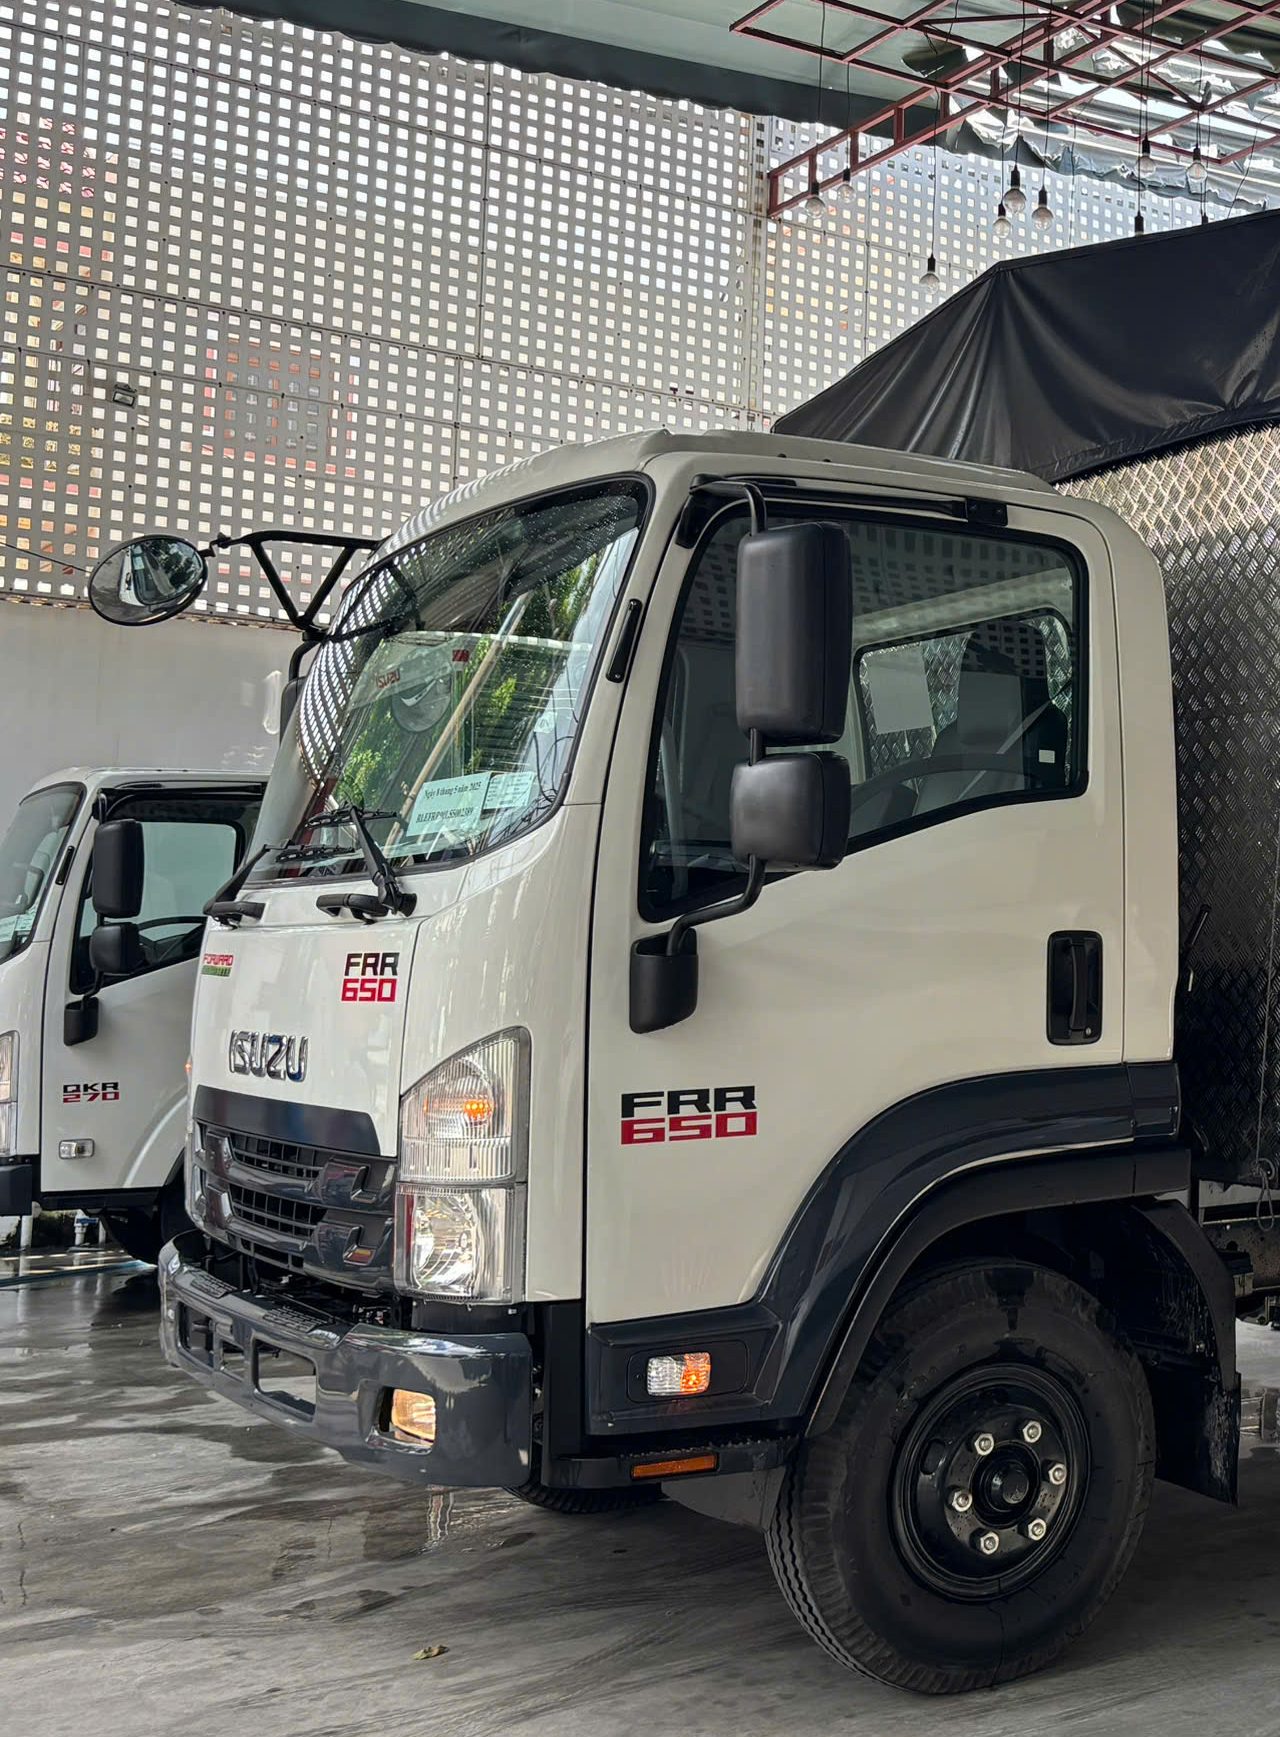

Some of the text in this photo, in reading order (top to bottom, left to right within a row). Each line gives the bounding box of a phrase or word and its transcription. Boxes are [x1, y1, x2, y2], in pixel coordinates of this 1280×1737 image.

[344, 952, 400, 976] FRR
[341, 978, 398, 1002] 650
[229, 1030, 309, 1082] ISUZU
[63, 1081, 119, 1093] QKR
[63, 1091, 120, 1103] 270
[621, 1086, 757, 1118] FRR
[621, 1111, 757, 1144] 650
